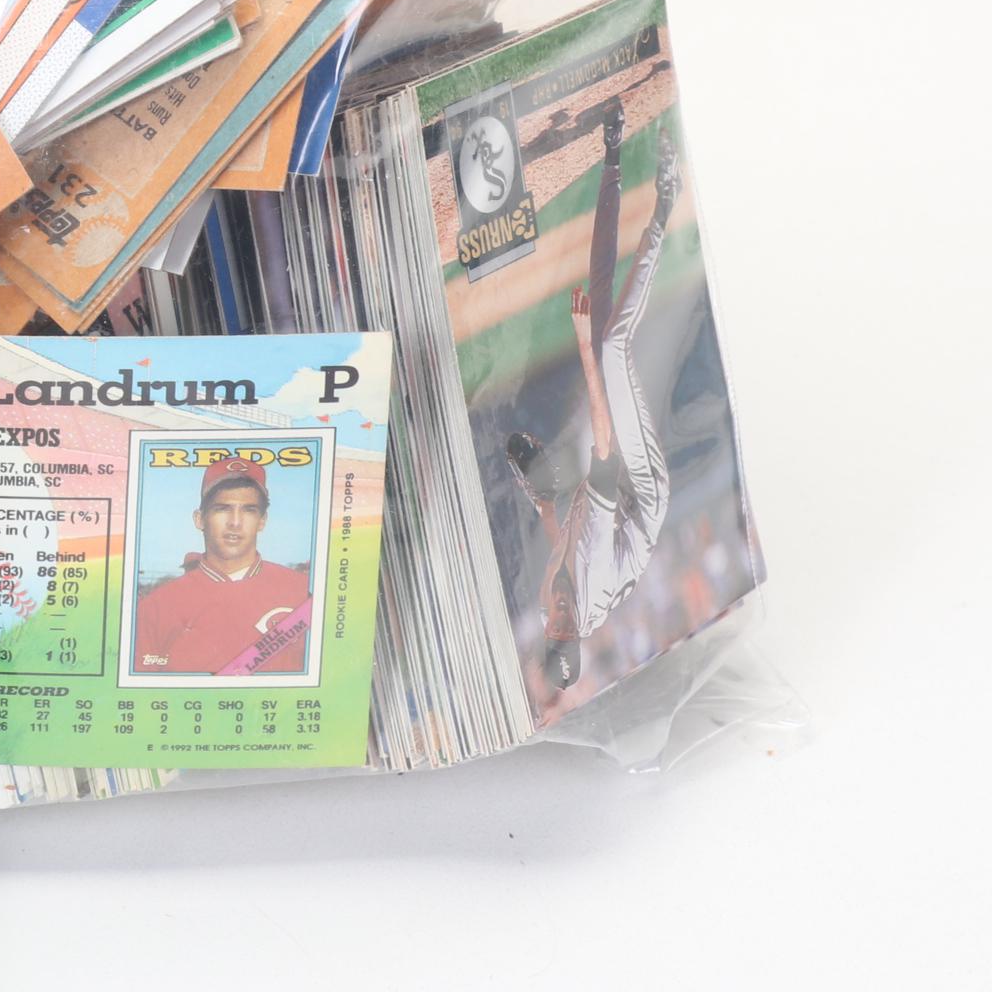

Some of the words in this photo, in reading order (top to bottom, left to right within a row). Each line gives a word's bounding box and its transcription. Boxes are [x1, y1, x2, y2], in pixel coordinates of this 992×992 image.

[161, 84, 186, 107] Hits
[143, 99, 172, 126] Runs
[45, 161, 99, 209] 231
[319, 365, 359, 403] P
[23, 463, 95, 477] COLUMBIA,
[97, 464, 115, 476] SC
[149, 446, 313, 469] REDS
[44, 476, 62, 488] SC
[343, 472, 356, 512] TOPPS
[341, 514, 352, 541] 1988
[36, 550, 86, 563] Behind
[337, 558, 349, 591] CARD
[335, 594, 348, 639] ROOKIE
[245, 619, 308, 673] LANDRUM
[255, 627, 284, 653] BILL
[218, 700, 244, 711] SHO
[296, 699, 321, 710] ERA
[297, 711, 321, 722] 3.18
[194, 743, 210, 753] THE
[212, 743, 240, 753] TOPPS
[243, 743, 294, 754] COMPANY,
[296, 743, 317, 753] INC.
